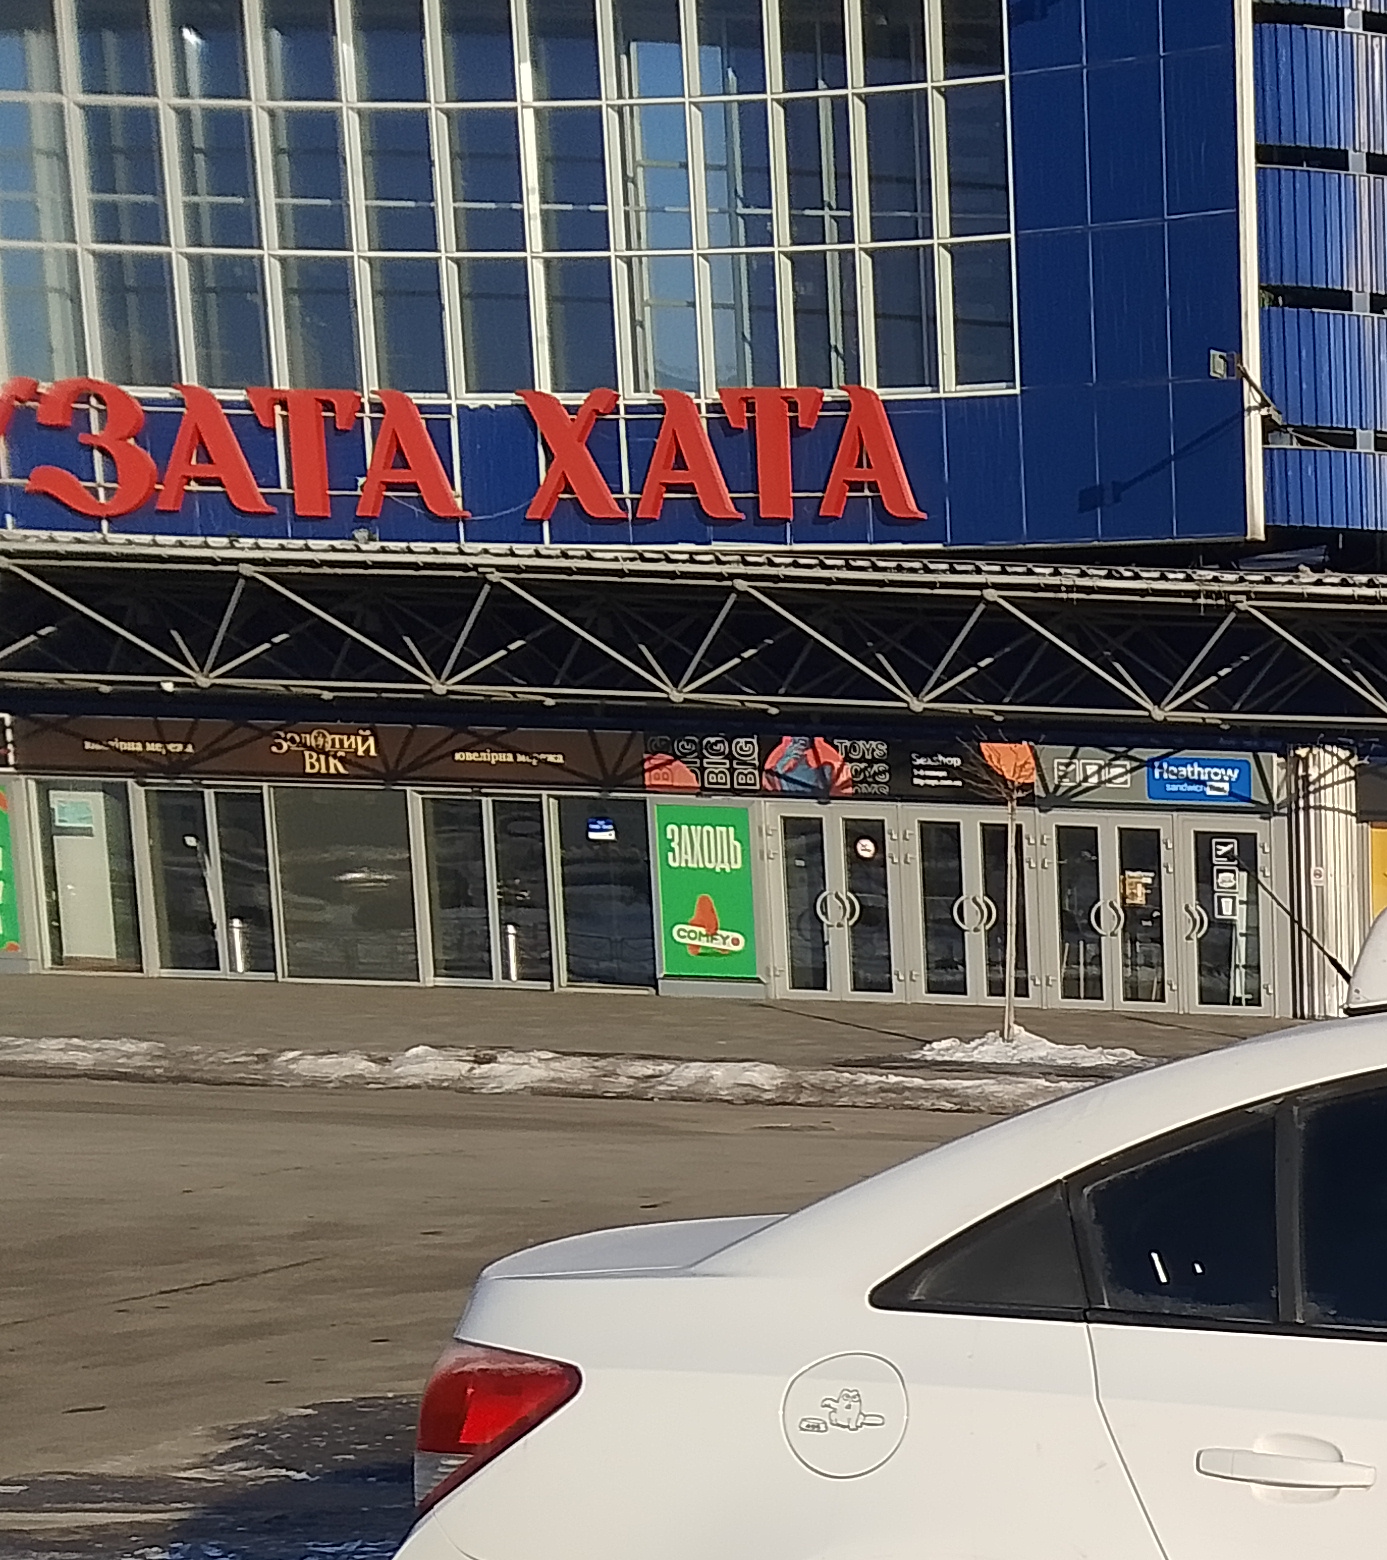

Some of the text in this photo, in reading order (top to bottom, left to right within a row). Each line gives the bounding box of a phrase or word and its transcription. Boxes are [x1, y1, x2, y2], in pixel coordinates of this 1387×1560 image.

[516, 385, 930, 523] ХАТА
[1153, 761, 1240, 781] Heathrow
[666, 824, 742, 872] ЗАХОДЬ
